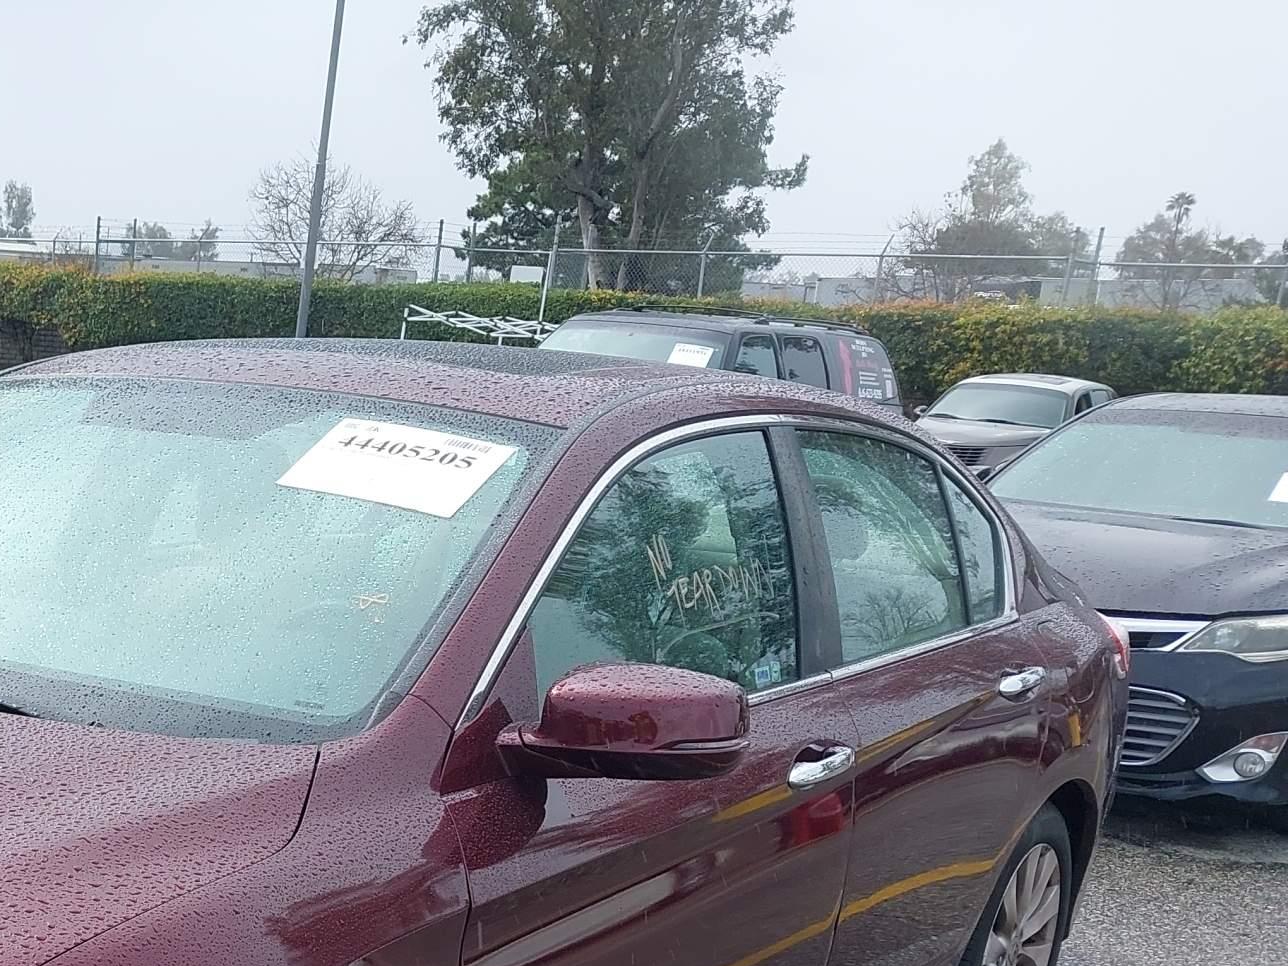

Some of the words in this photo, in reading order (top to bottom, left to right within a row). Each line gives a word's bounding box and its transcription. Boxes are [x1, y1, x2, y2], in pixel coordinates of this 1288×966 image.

[337, 434, 478, 470] 44405205
[667, 569, 724, 628] TEAR
[713, 534, 776, 602] DOWN
